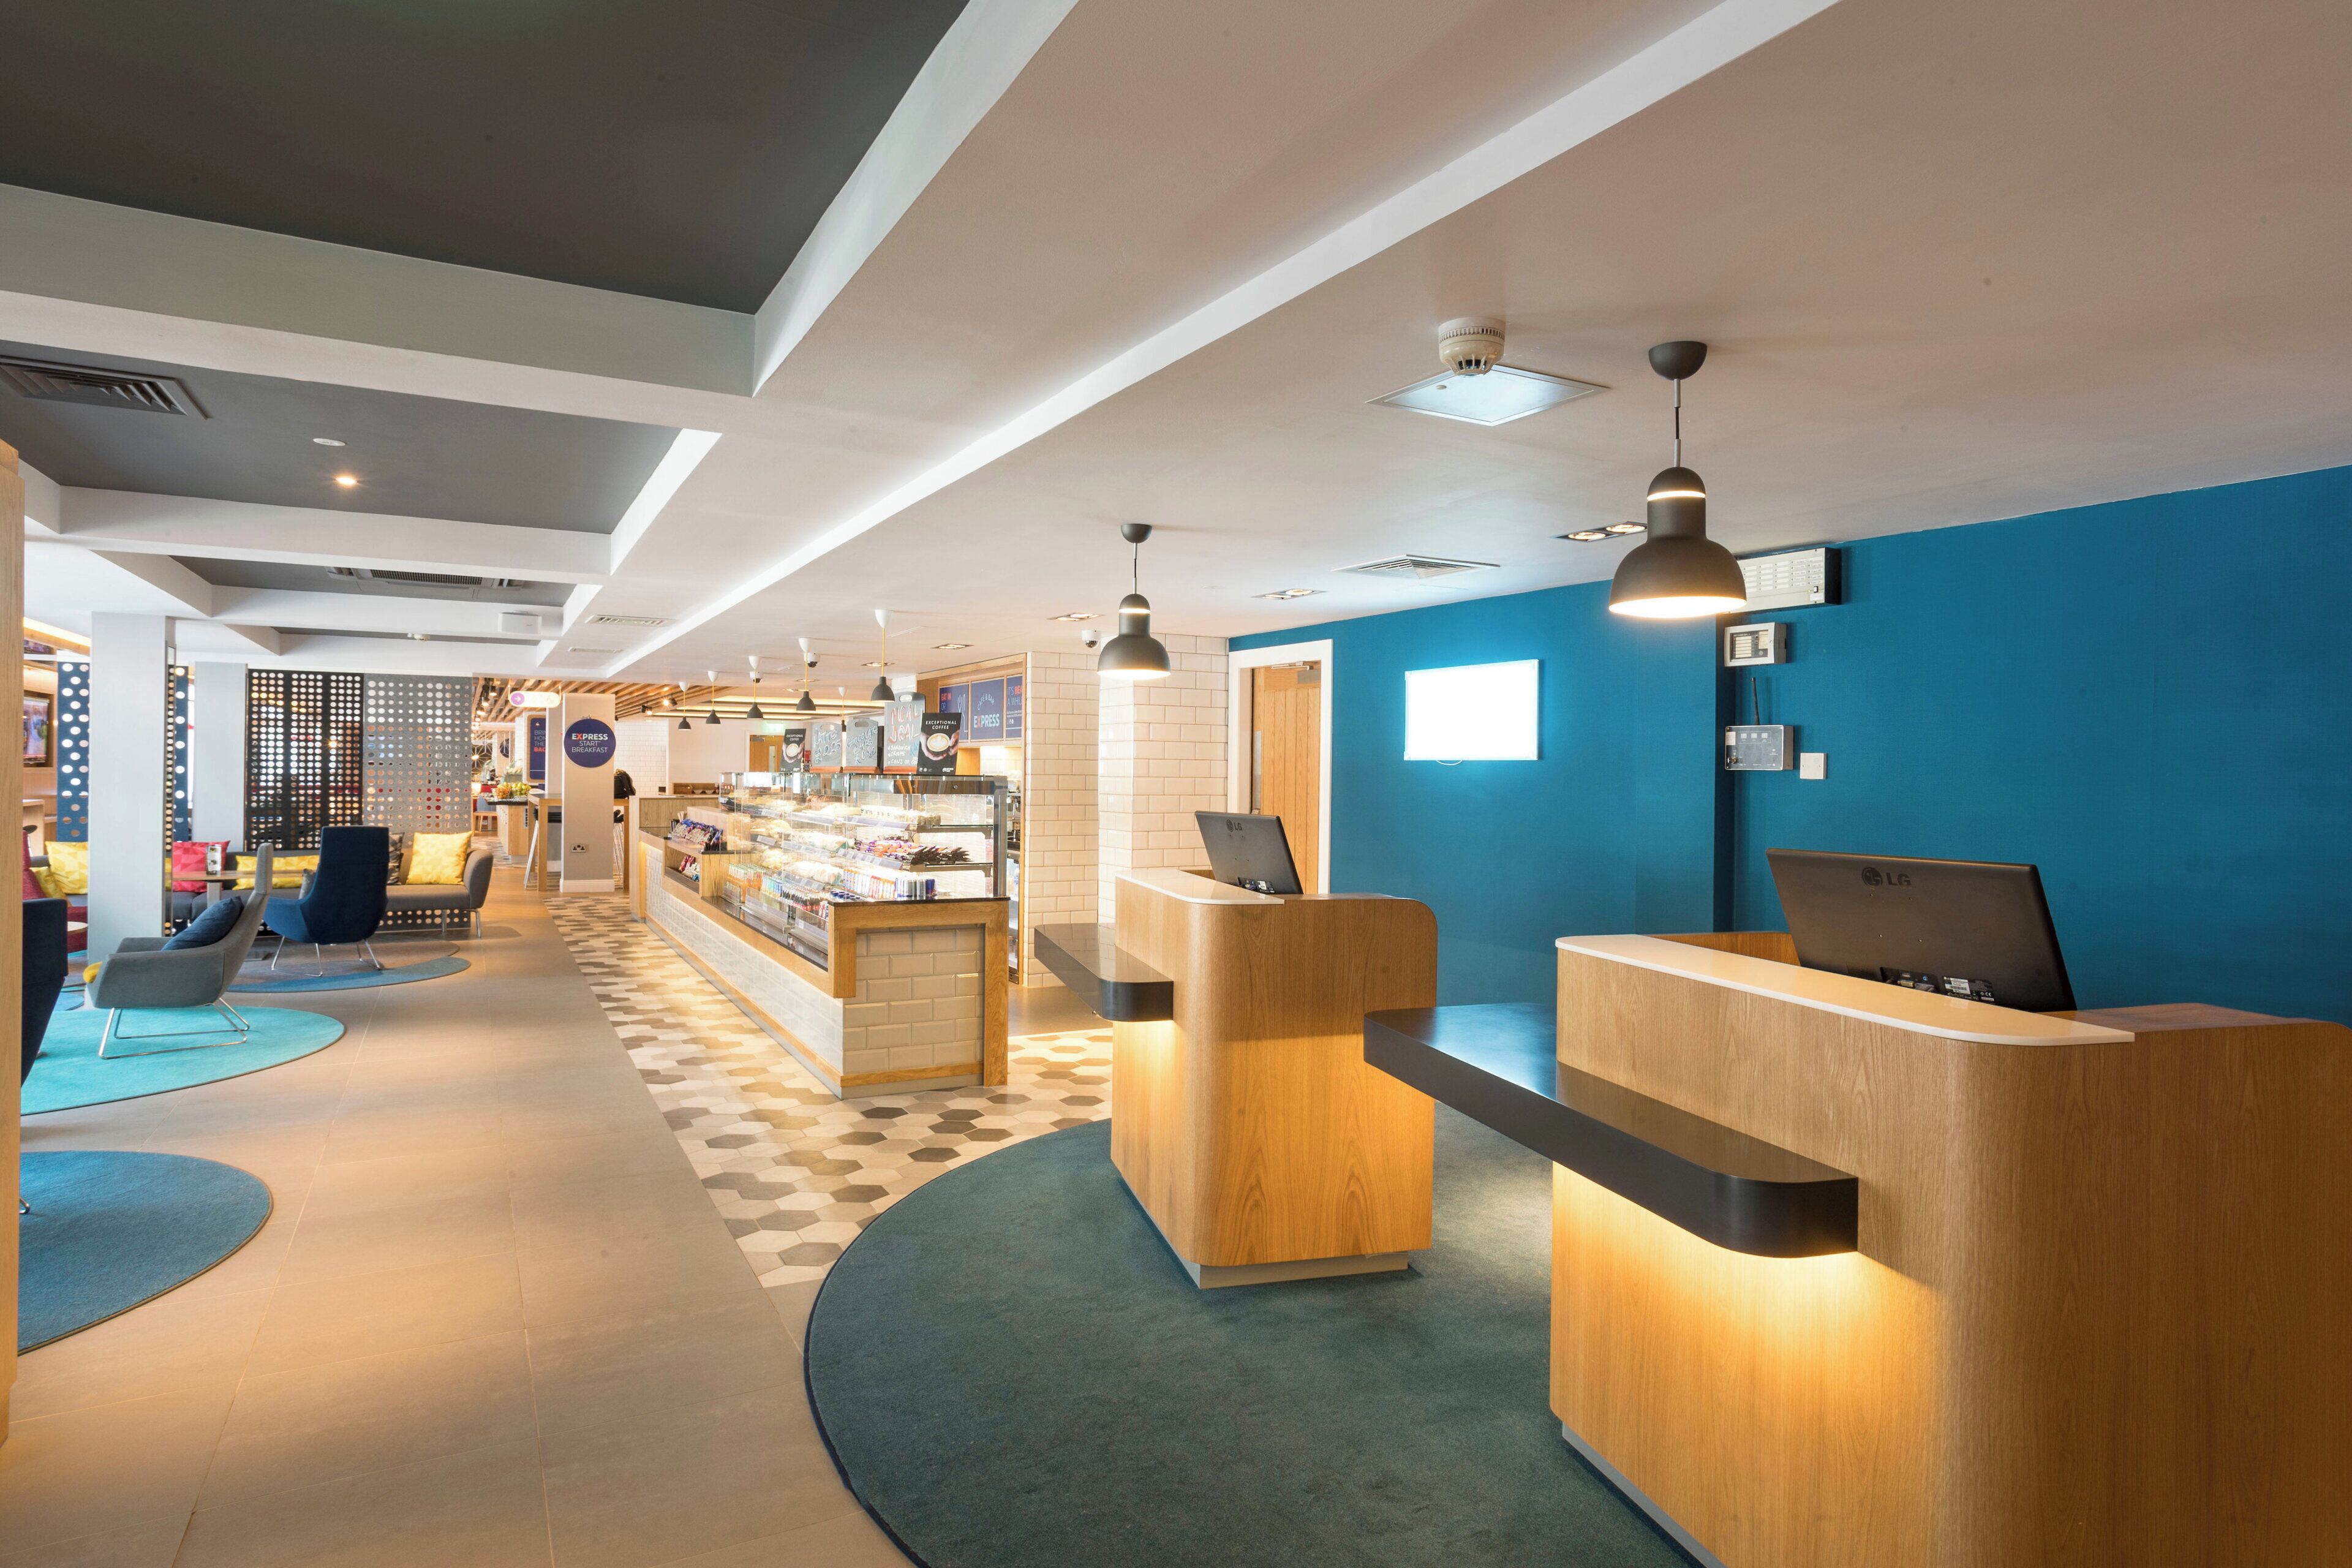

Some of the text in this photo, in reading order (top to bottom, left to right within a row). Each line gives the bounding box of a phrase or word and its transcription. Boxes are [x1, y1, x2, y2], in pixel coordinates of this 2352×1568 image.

[948, 692, 951, 701] IN
[941, 702, 946, 710] OR
[891, 704, 921, 725] MEAL
[974, 714, 1000, 728] EXPRESS
[813, 730, 837, 747] LATTE
[847, 725, 878, 747] CHOCOLATE
[888, 723, 919, 744] DEAL
[1886, 872, 1912, 886] LG
